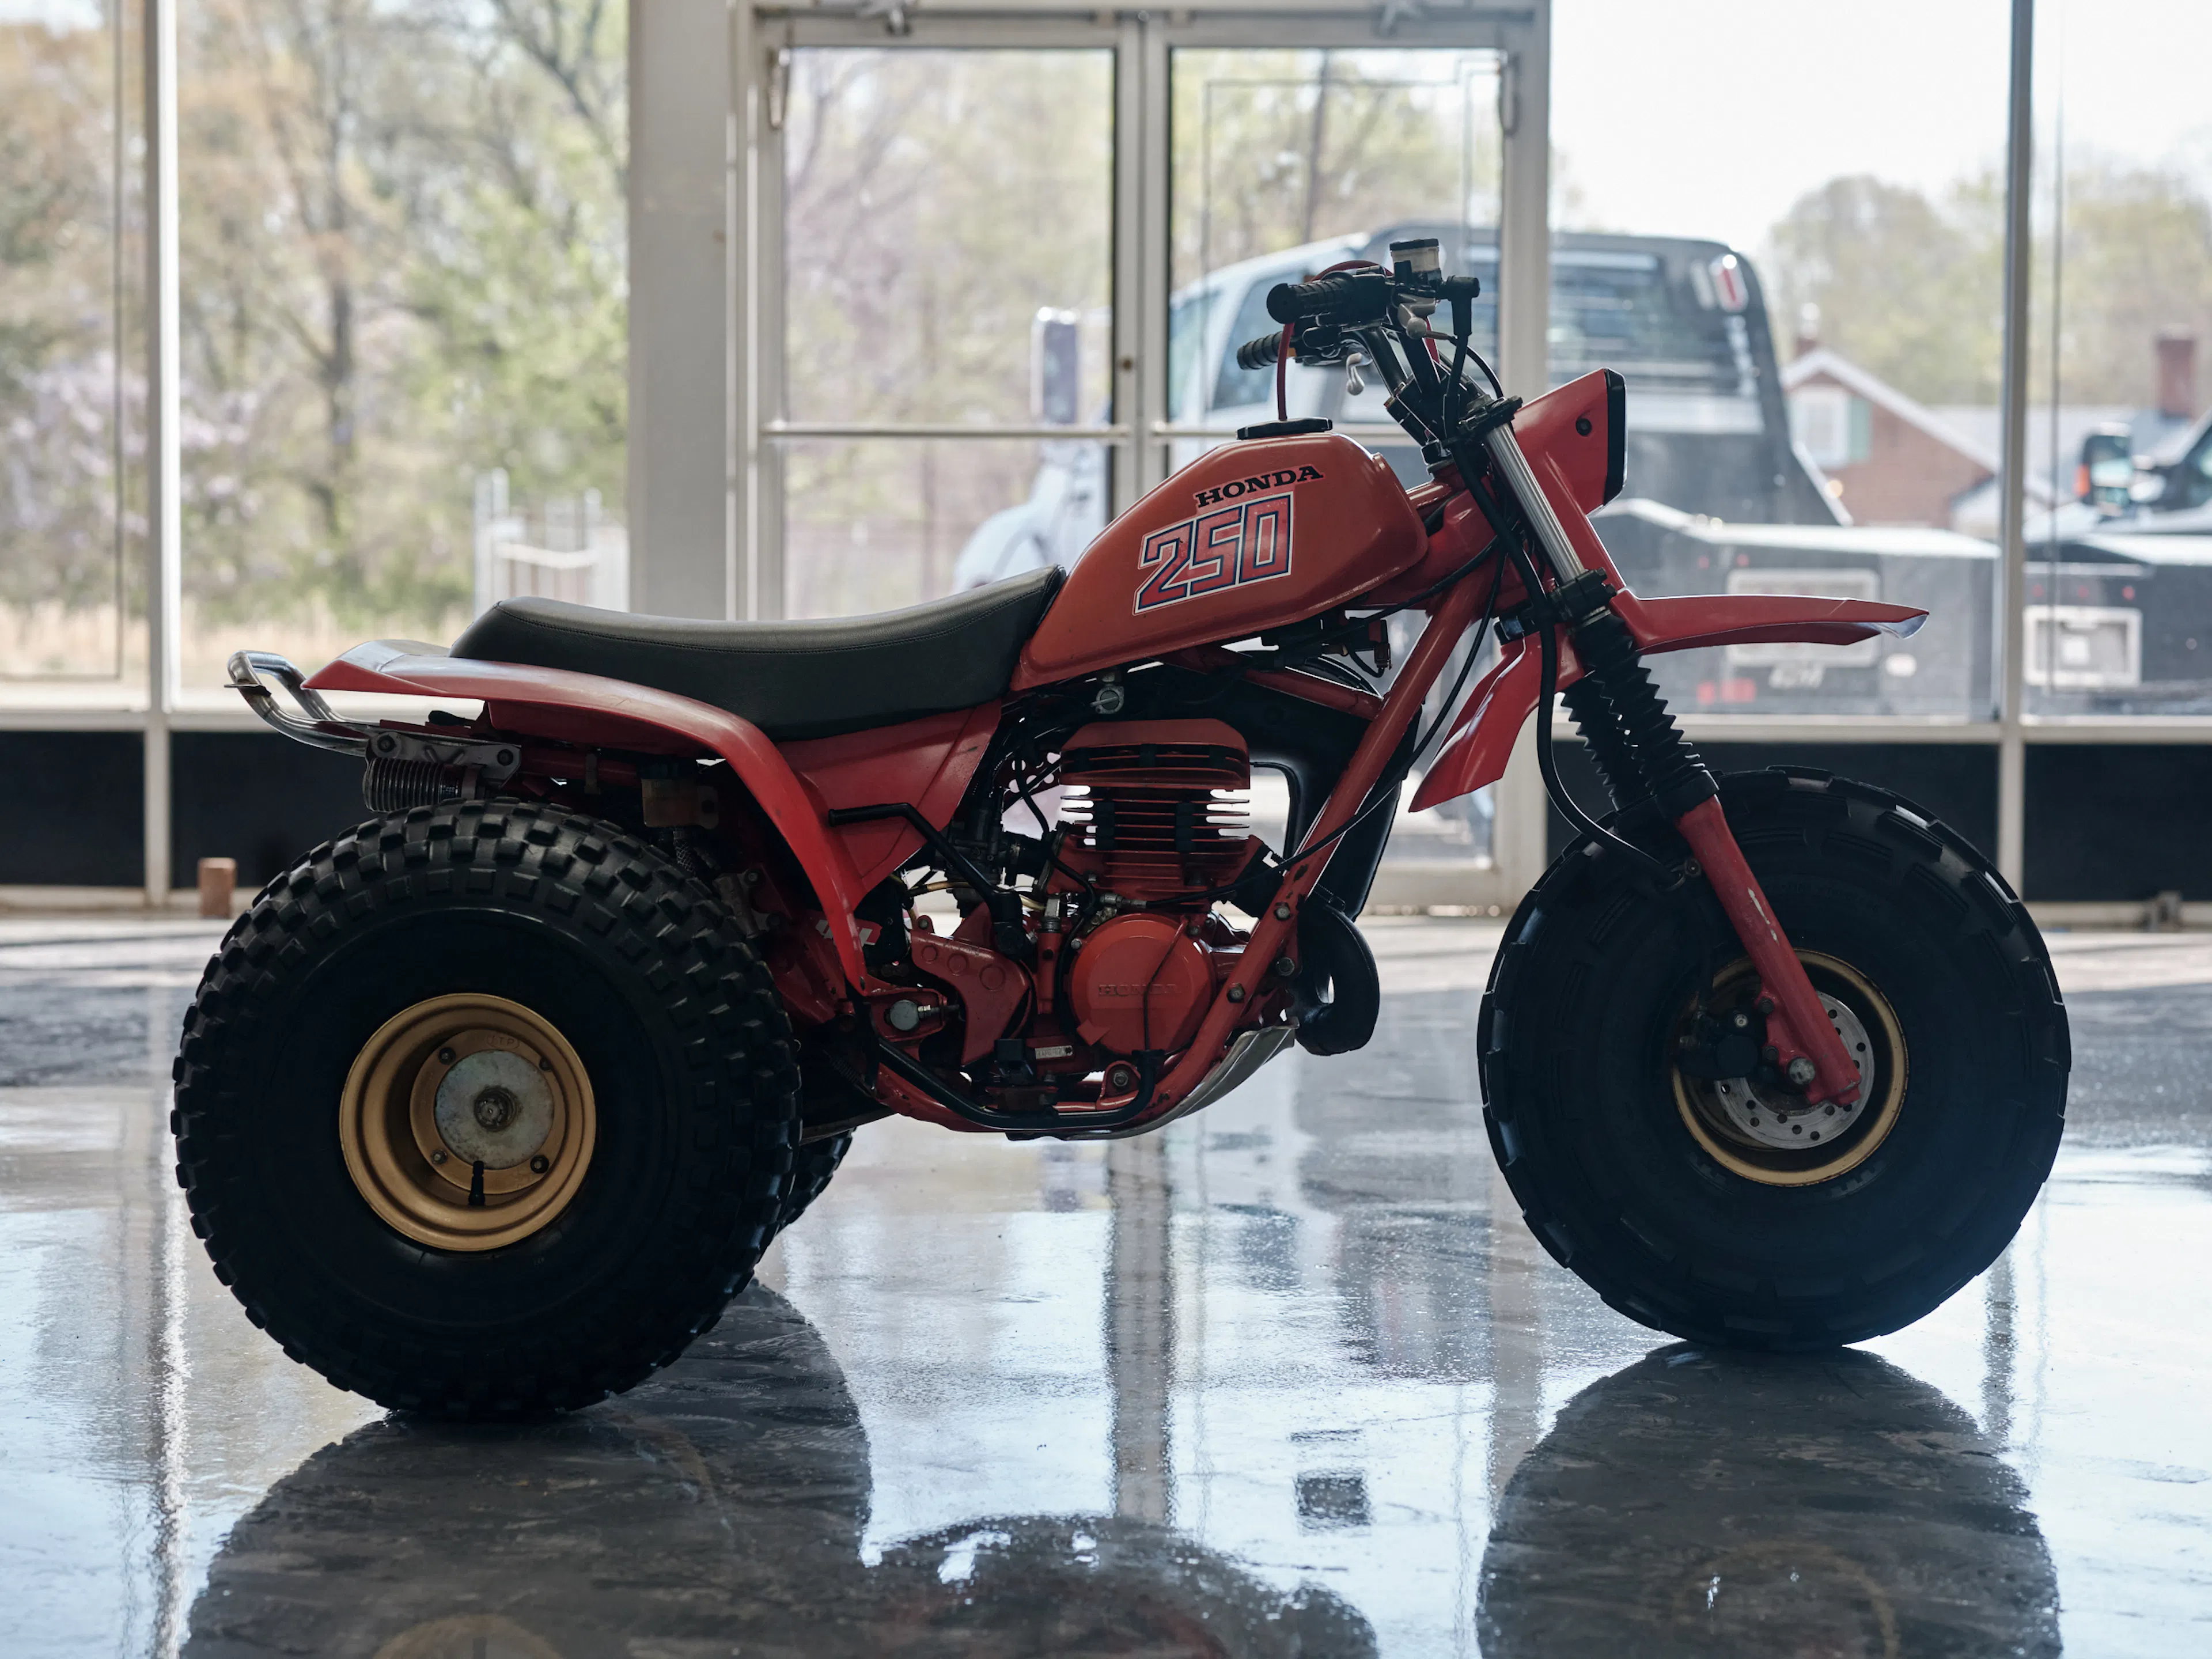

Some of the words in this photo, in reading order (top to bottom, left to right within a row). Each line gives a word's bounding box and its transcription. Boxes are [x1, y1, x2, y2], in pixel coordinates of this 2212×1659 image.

[1195, 465, 1324, 507] HONDA
[1134, 491, 1294, 614] 250
[1098, 983, 1182, 997] HONDA
